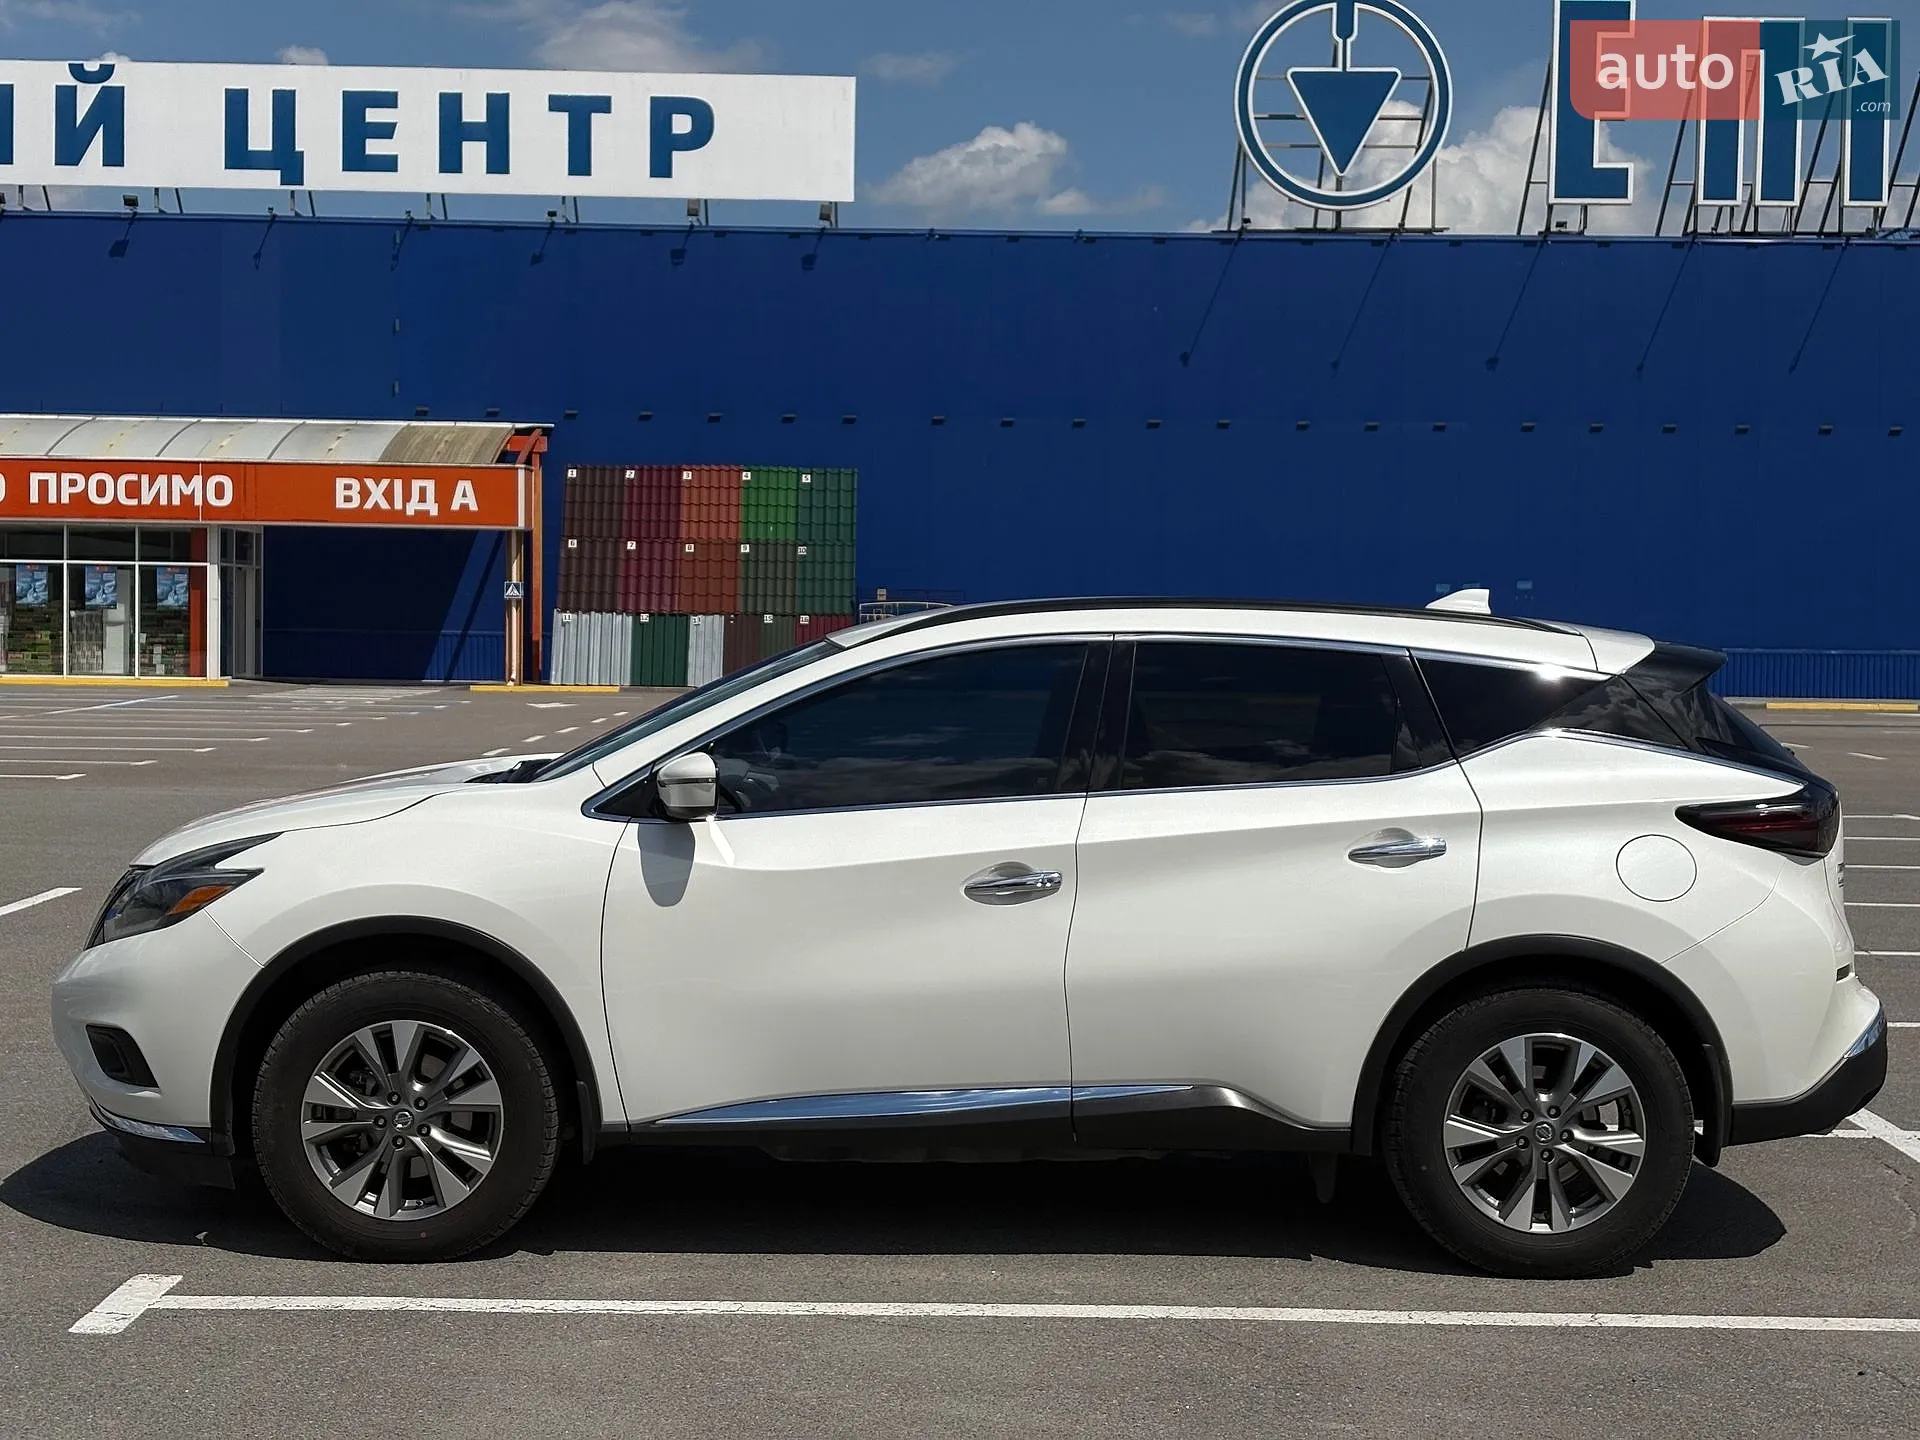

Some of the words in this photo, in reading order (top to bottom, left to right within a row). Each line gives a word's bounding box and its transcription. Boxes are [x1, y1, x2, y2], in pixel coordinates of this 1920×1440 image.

[223, 87, 716, 186] ЦЕНТР
[29, 472, 233, 507] ПРОСИМО
[335, 477, 439, 516] ВХІД
[450, 479, 479, 511] А
